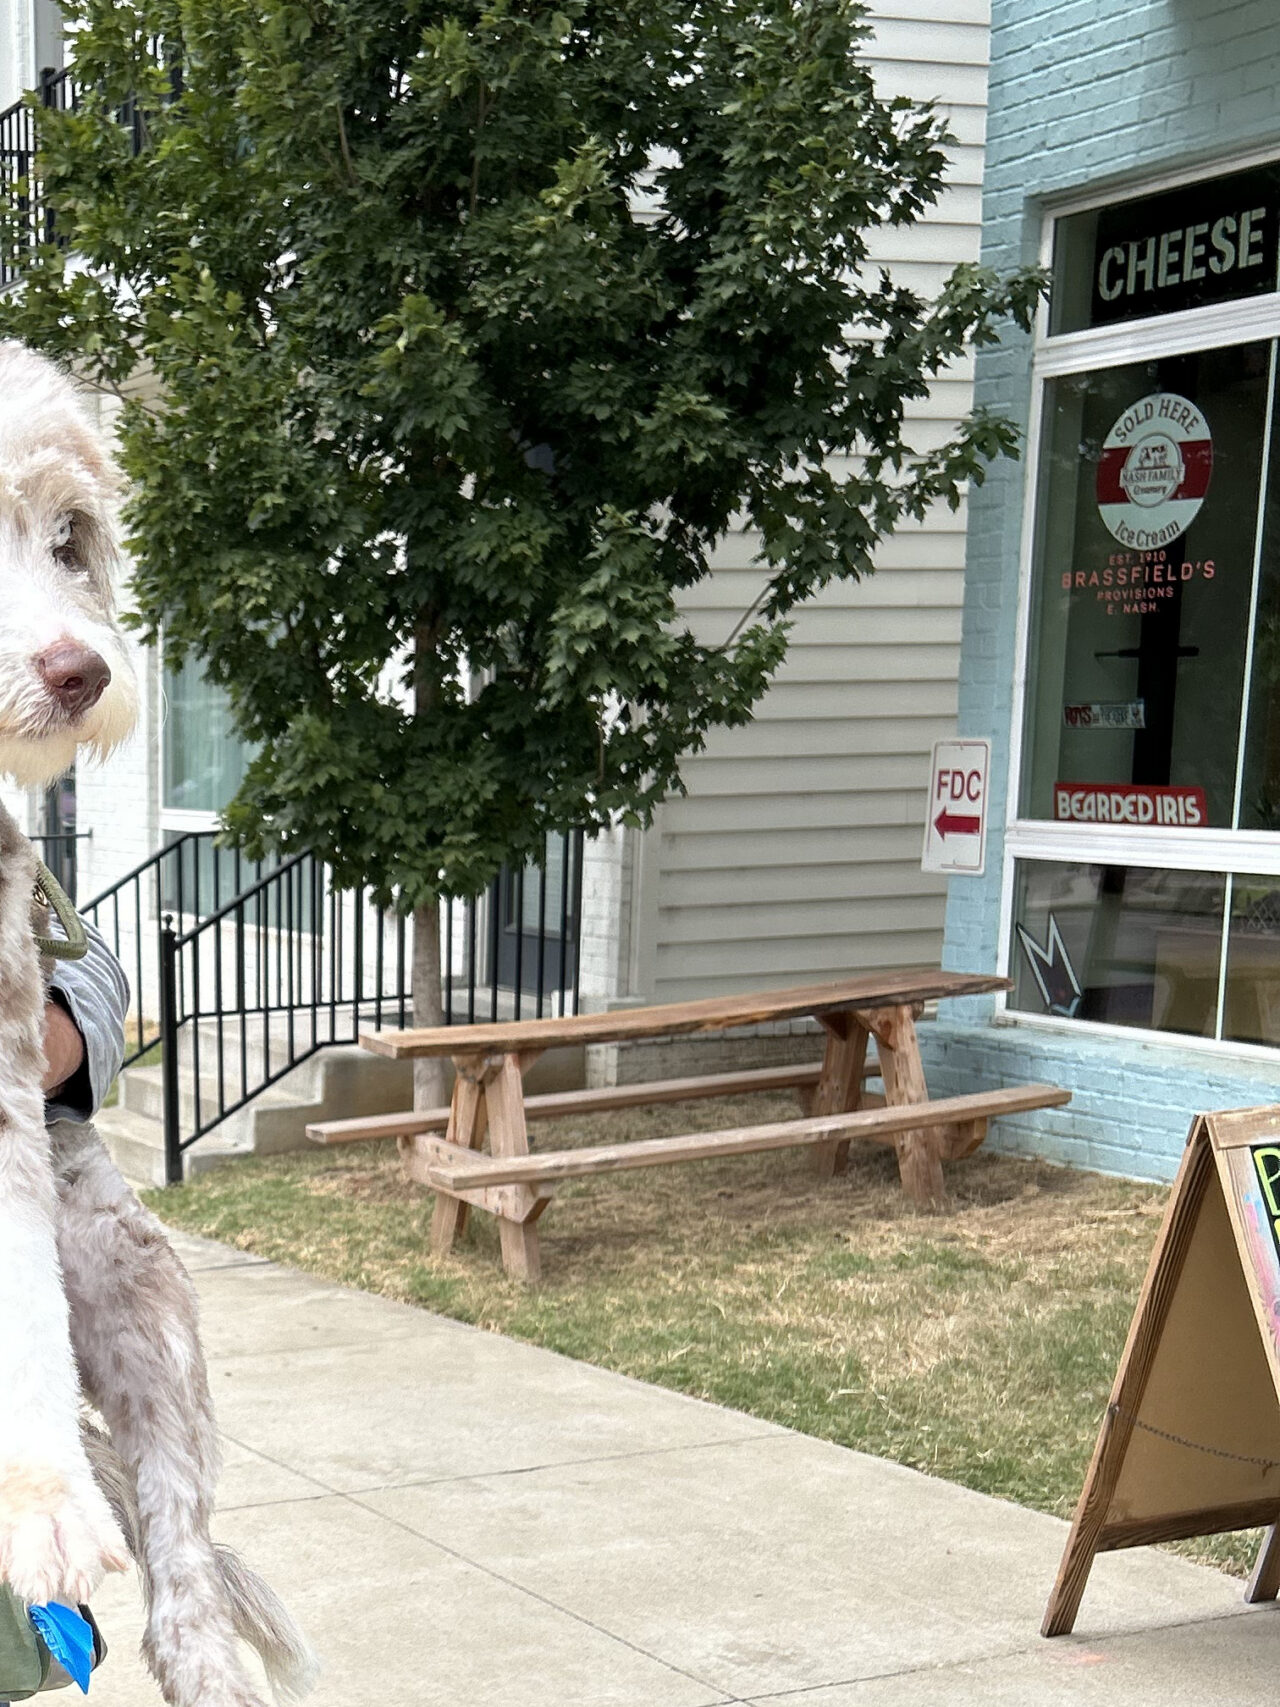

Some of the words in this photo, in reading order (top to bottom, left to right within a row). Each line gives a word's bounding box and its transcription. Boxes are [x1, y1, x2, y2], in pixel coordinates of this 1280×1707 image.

[1098, 207, 1266, 300] CHEESE
[1115, 402, 1154, 443] SOLD
[1158, 398, 1199, 434] HERE
[1122, 471, 1148, 482] NASH
[1148, 469, 1182, 481] FAMILY
[1115, 519, 1135, 542] Ice
[1136, 520, 1180, 547] Cream
[1139, 550, 1167, 563] 1910
[1061, 560, 1215, 589] BRASSFIELD'S
[1097, 587, 1174, 601] PROVISIONS
[937, 769, 981, 802] FDC
[1057, 791, 1154, 822] BEARDED
[1155, 794, 1201, 824] IRIS
